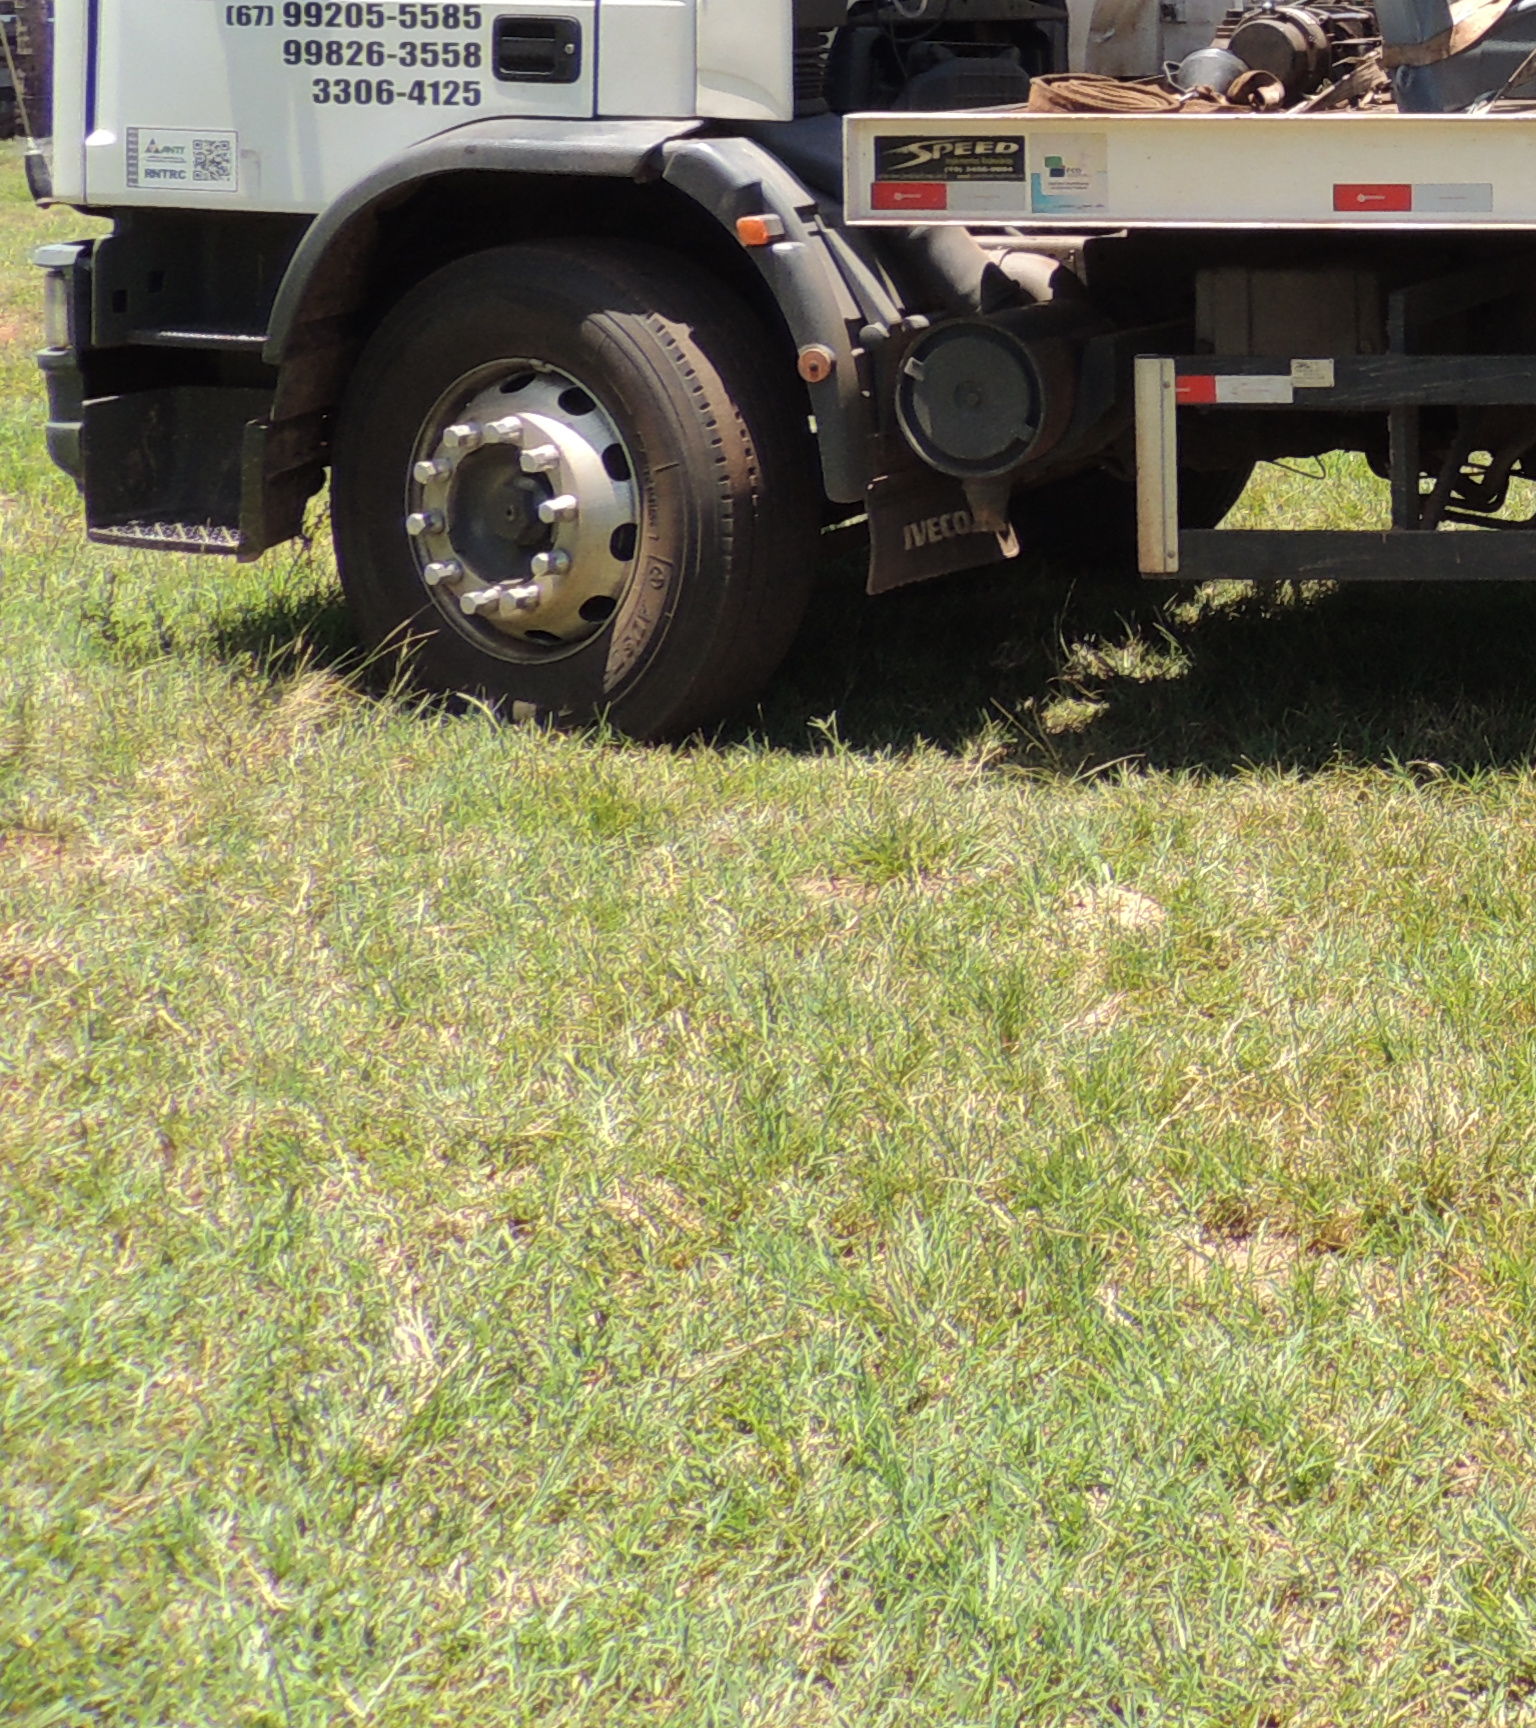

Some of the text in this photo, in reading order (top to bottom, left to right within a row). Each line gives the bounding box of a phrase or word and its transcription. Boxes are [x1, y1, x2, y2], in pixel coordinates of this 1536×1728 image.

[225, 2, 482, 30] (67) 99205-5585
[282, 40, 482, 69] 99826-3558
[312, 79, 482, 108] 3306-4125
[885, 138, 1020, 171] SPEED
[901, 510, 972, 552] IVECO
